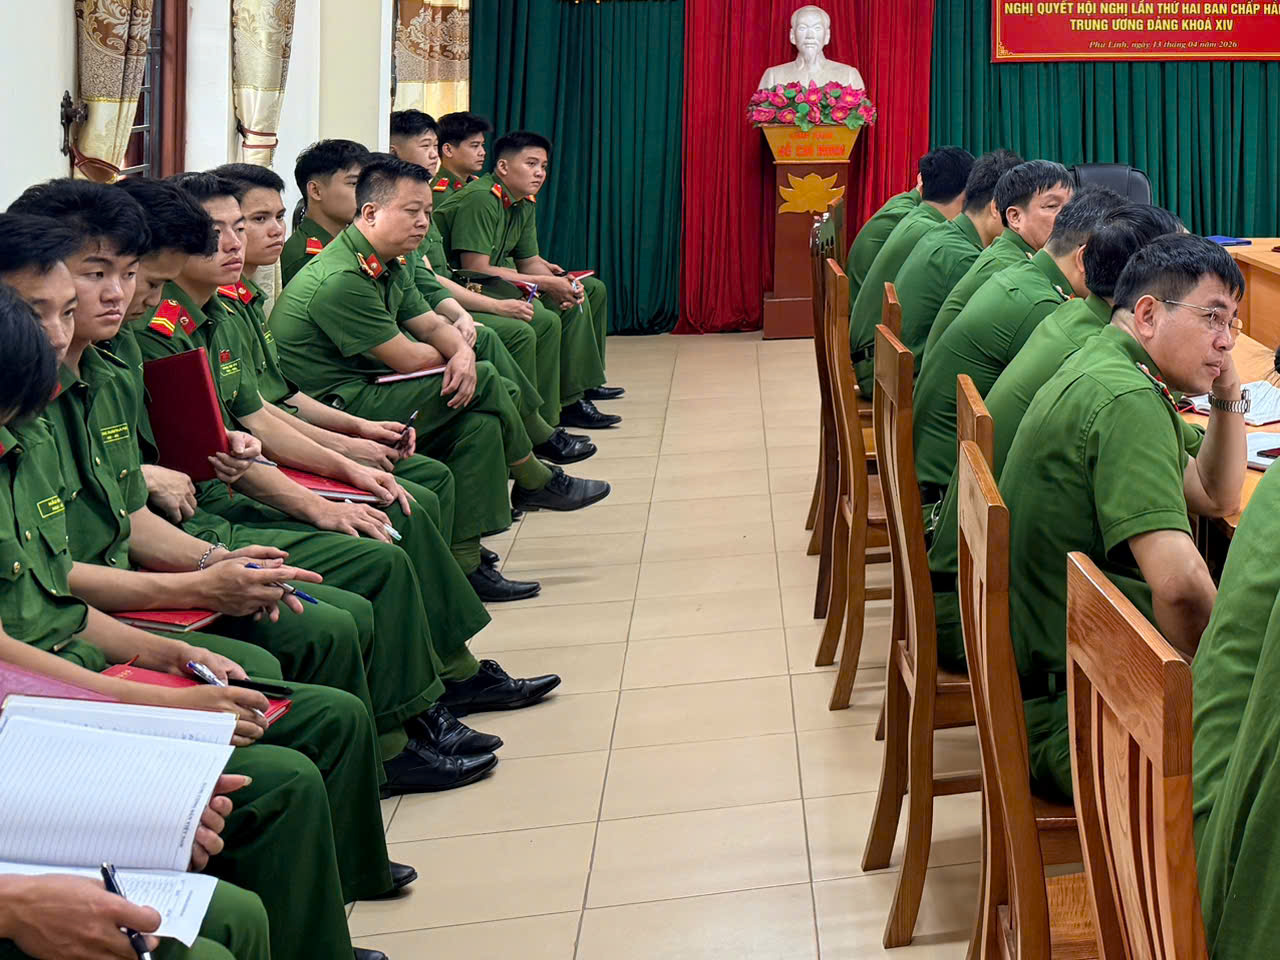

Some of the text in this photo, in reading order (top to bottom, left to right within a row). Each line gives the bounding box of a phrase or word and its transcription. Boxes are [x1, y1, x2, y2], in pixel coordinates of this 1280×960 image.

[1004, 2, 1034, 17] NGHỊ
[1077, 0, 1097, 17] HỘI
[1100, 2, 1128, 17] NGHỊ
[1182, 3, 1201, 15] HAI
[1204, 3, 1228, 15] BAN
[1230, 0, 1261, 15] CHẤP
[1070, 16, 1233, 31] TRUNG ƯƠNG ĐẢNG KHOÁ XIV
[1218, 41, 1238, 49] 2026
